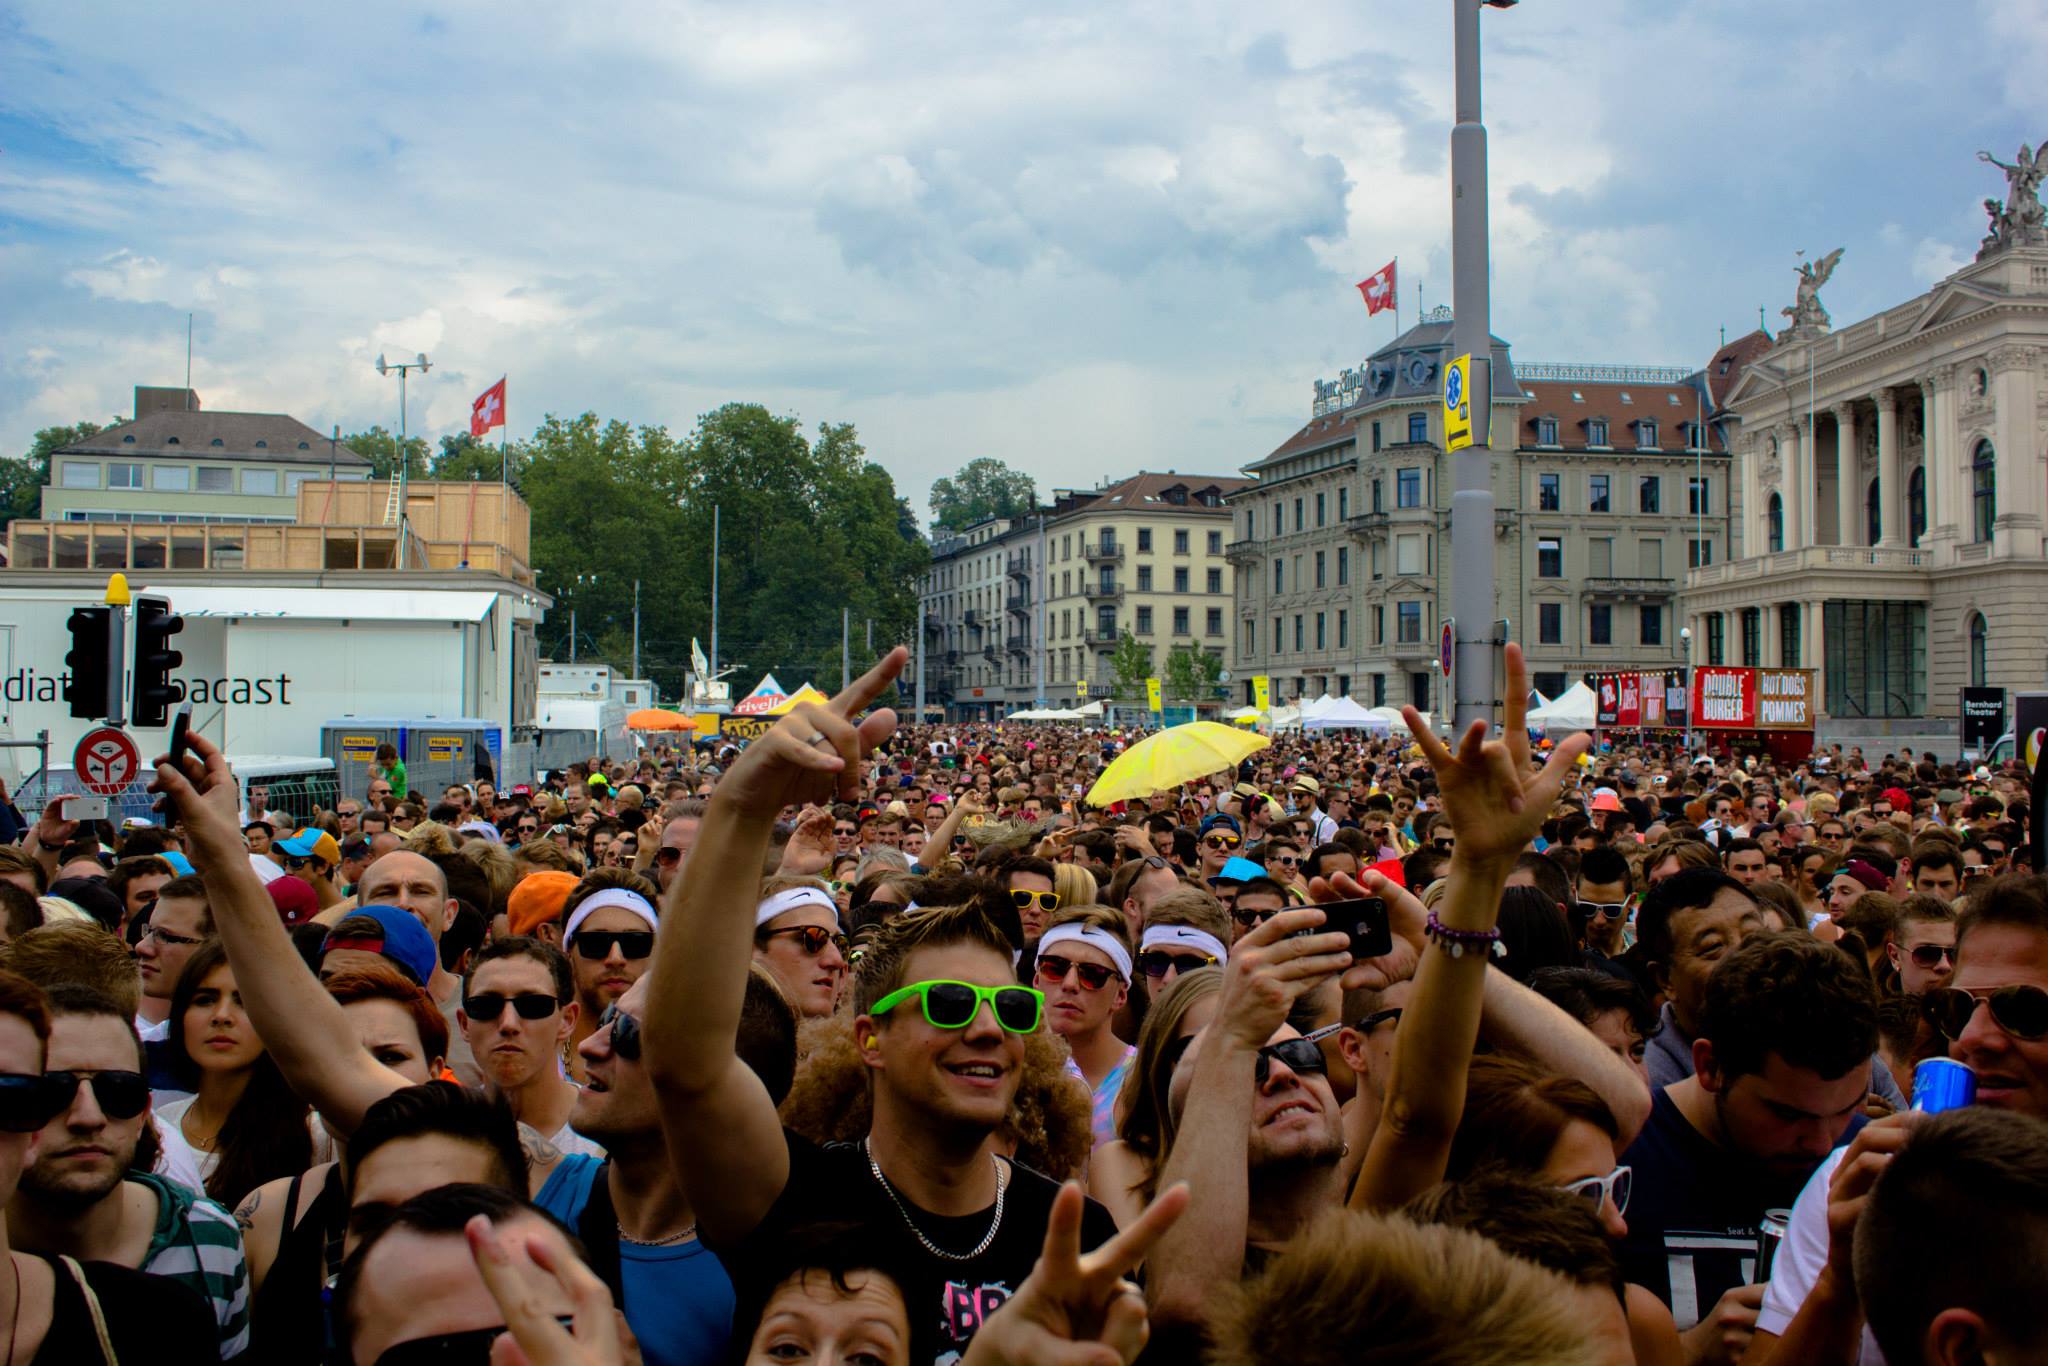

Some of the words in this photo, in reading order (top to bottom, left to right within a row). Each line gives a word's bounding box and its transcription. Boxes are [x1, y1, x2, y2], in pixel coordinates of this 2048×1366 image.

[1703, 673, 1745, 697] DOUBLE
[1761, 675, 1780, 695] HOT
[1782, 676, 1806, 695] DOGS
[737, 697, 783, 712] rivell
[1703, 698, 1743, 720] BURGER
[1761, 701, 1805, 722] POMMES
[1965, 700, 2002, 709] Bernhard
[1965, 708, 1997, 716] Theater
